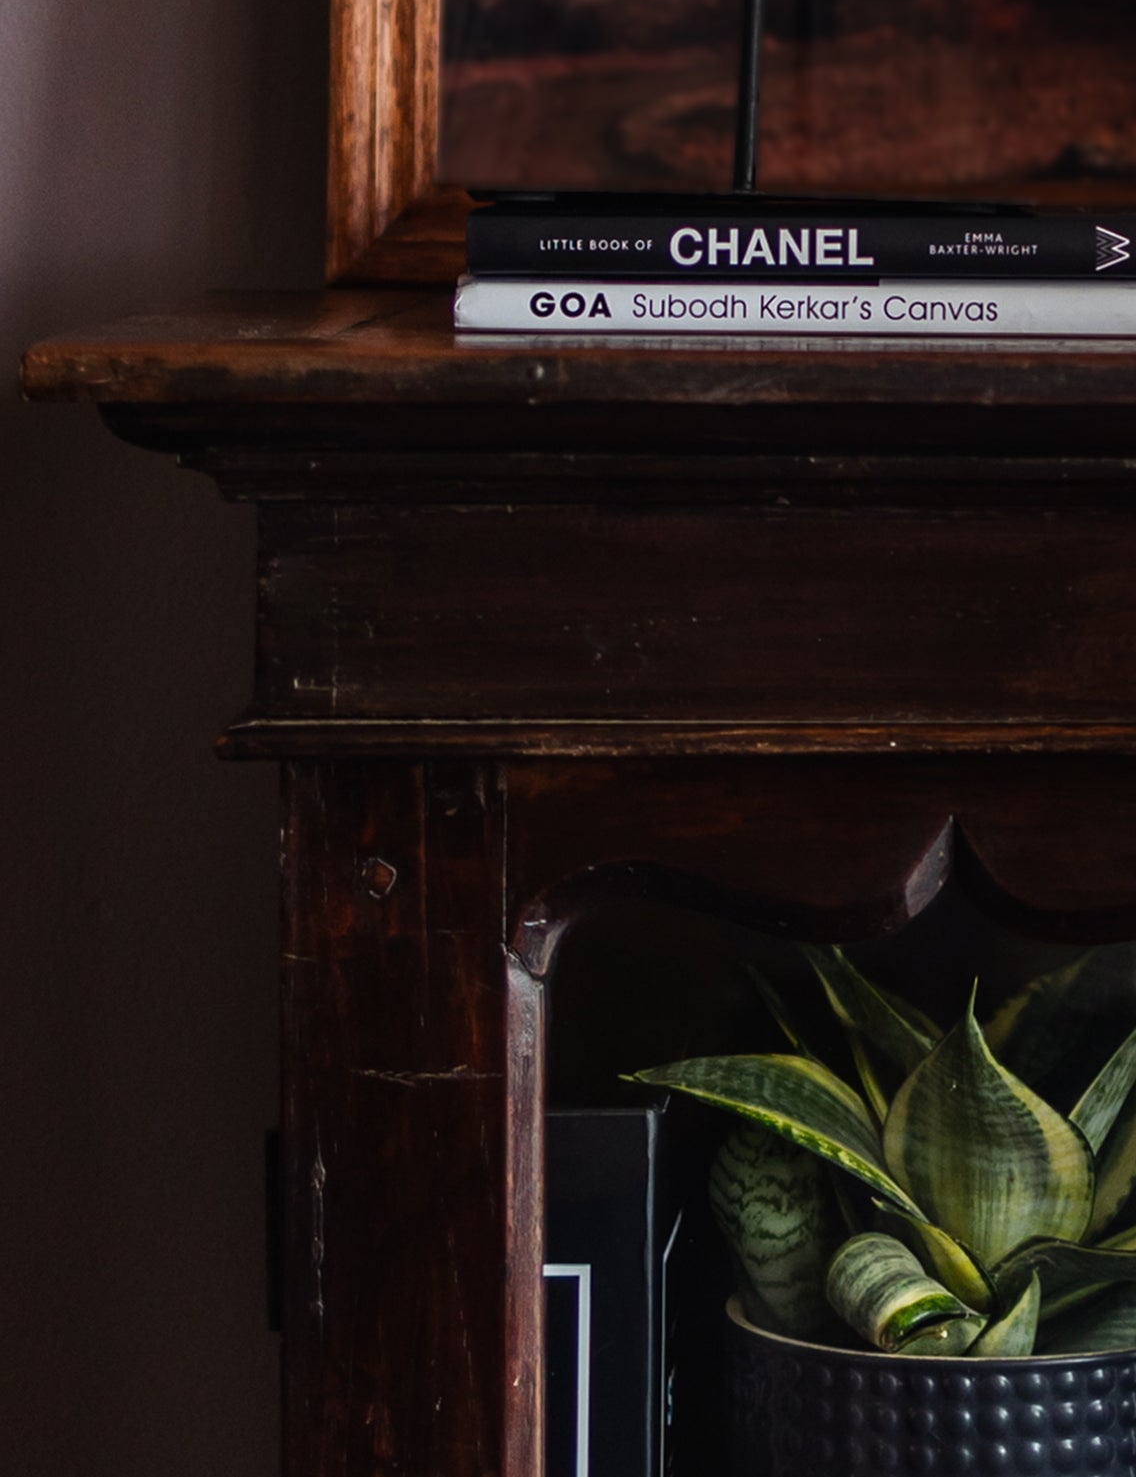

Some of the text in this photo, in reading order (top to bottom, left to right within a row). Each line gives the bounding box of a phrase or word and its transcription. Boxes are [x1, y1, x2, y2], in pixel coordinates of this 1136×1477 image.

[539, 227, 875, 266] LITTLE BOOK OF CHANEL
[964, 232, 1003, 243] EMMA
[929, 244, 1038, 256] BAXTER-WRIGHT
[529, 292, 612, 318] GOA
[632, 293, 747, 319] Subodh
[883, 295, 998, 322] Canvas
